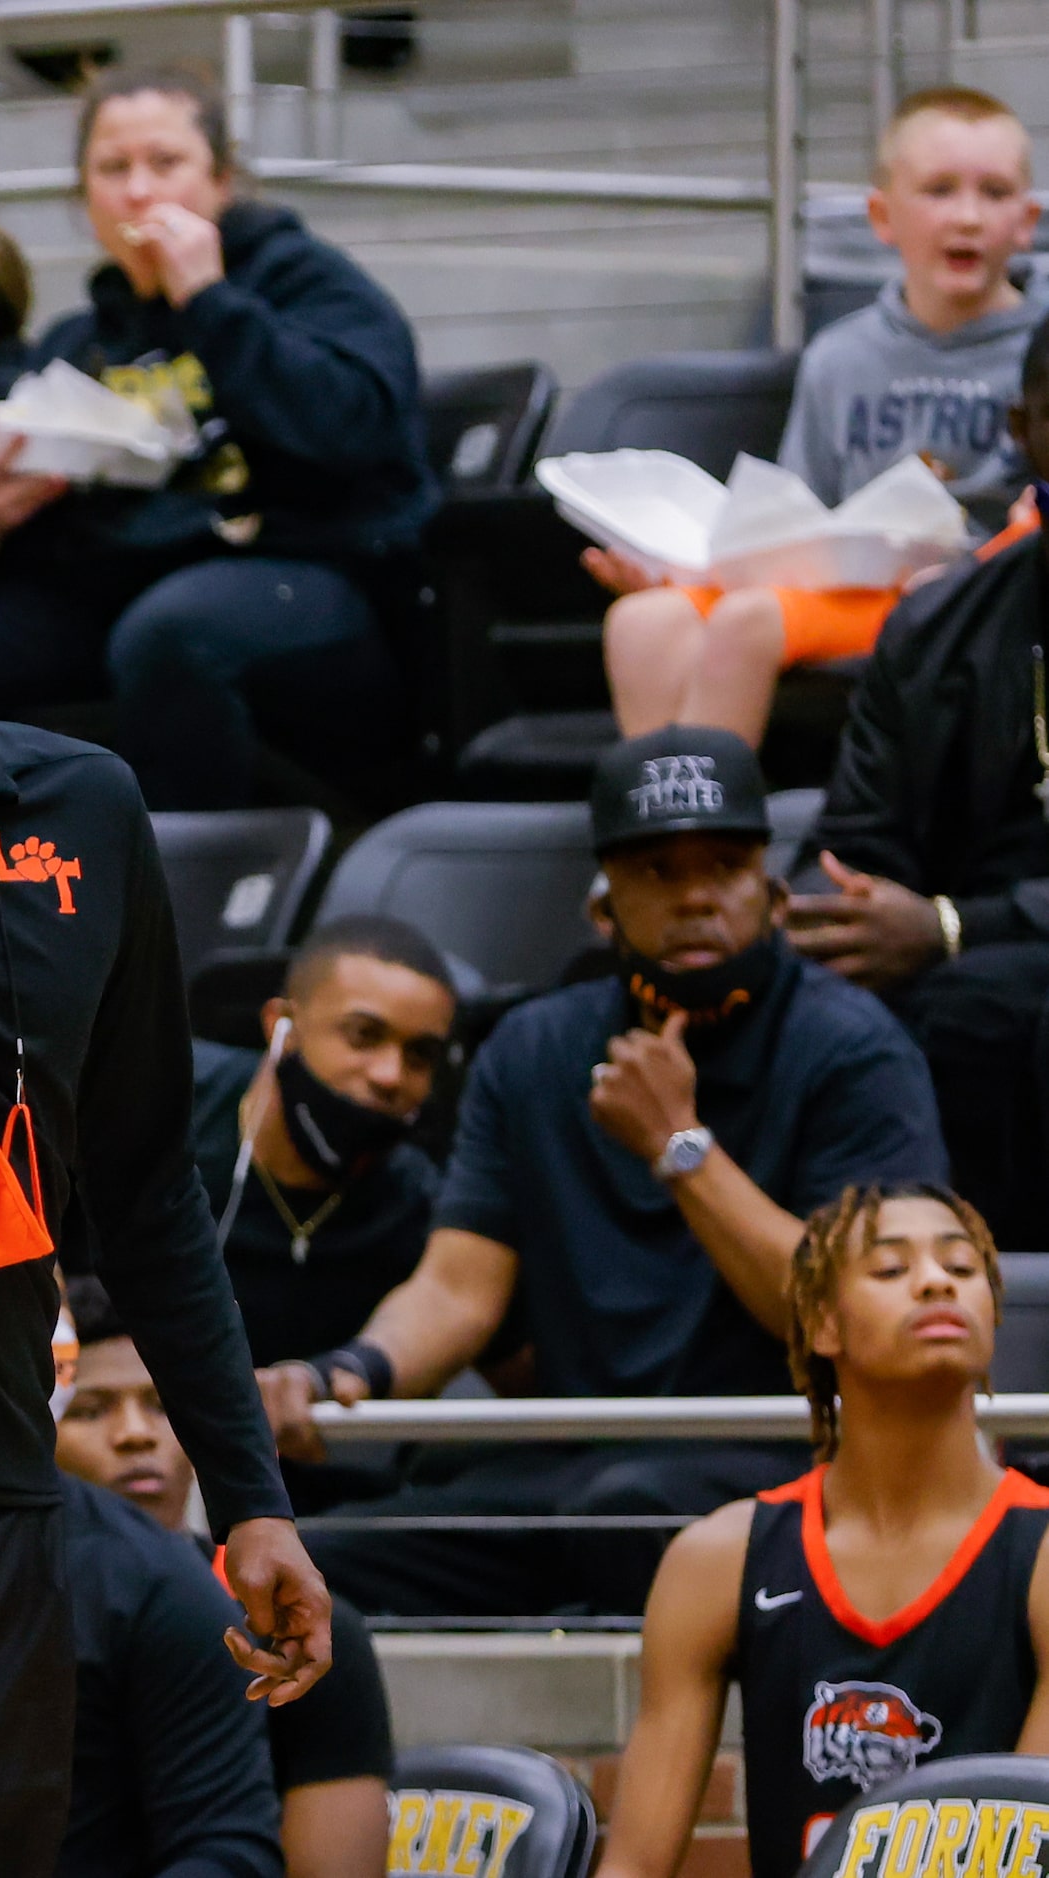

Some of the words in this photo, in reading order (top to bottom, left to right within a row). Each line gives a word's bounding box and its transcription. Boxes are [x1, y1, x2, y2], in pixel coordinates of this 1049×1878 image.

[847, 396, 1006, 454] ASTRO
[643, 755, 716, 784] STAY
[386, 1789, 534, 1878] RNEY
